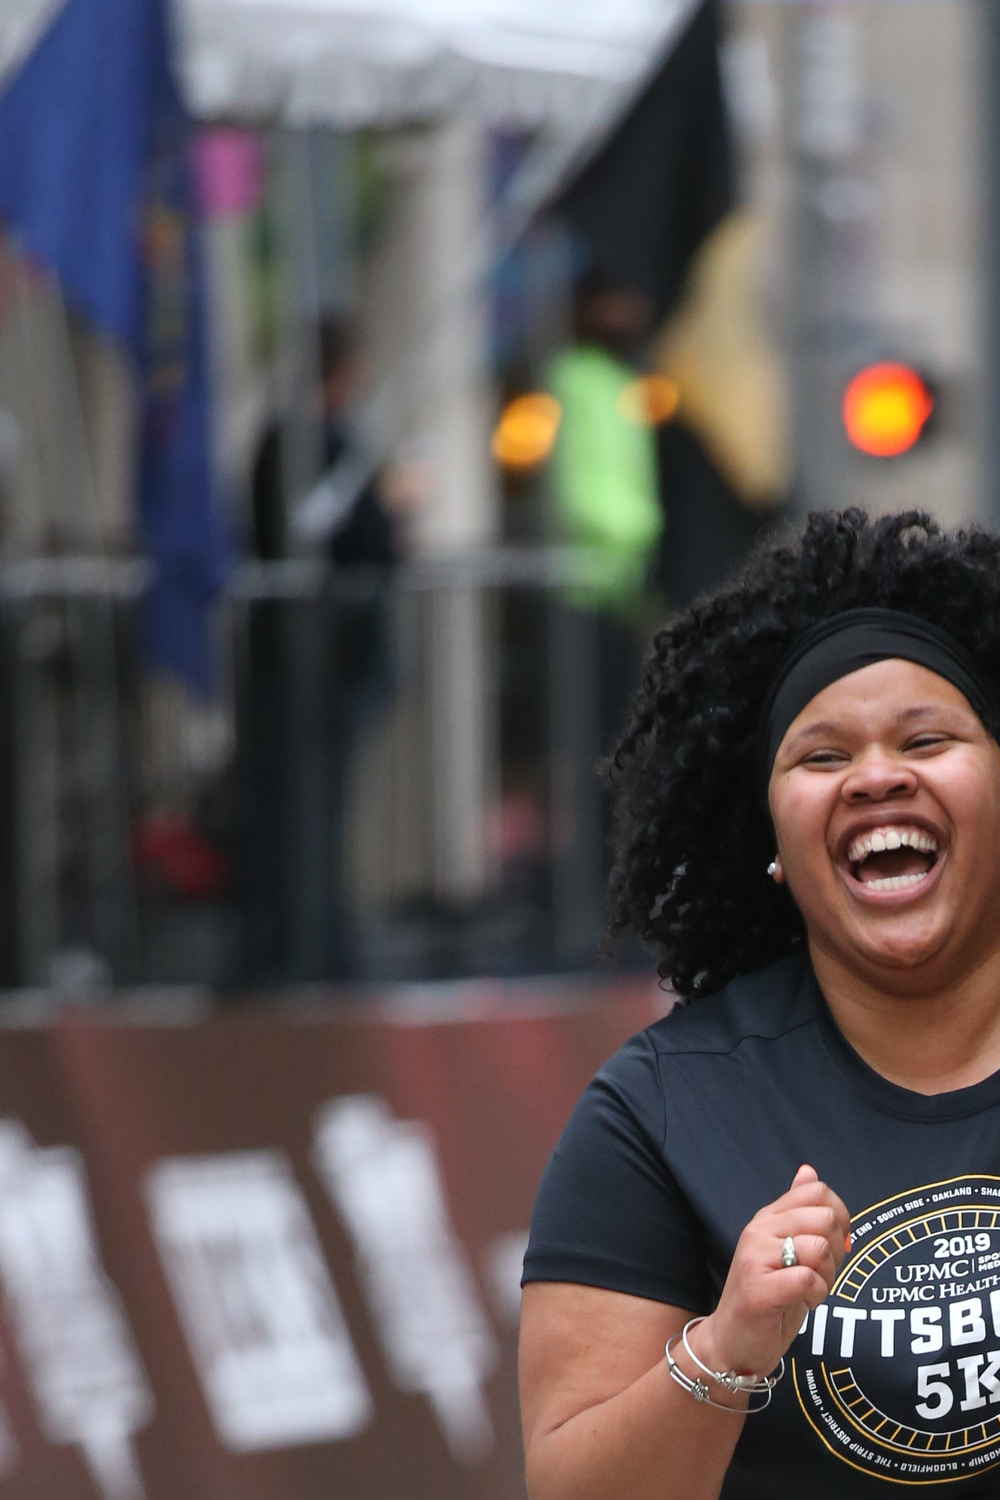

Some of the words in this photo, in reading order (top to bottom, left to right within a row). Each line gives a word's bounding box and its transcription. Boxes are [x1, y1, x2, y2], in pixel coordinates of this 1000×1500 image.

[855, 1221, 873, 1237] END
[876, 1205, 905, 1224] SOUTH
[905, 1198, 925, 1212] SIDE
[931, 1186, 972, 1203] OAKLAND
[933, 1232, 992, 1259] 2019
[894, 1259, 970, 1283] UPMC
[871, 1285, 935, 1303] UPMC
[805, 1369, 823, 1406] UPTOWN
[821, 1412, 851, 1446] DISTRICT
[849, 1441, 874, 1461] STRIP
[874, 1455, 892, 1468] THE
[900, 1462, 958, 1473] BLOOMFIELD
